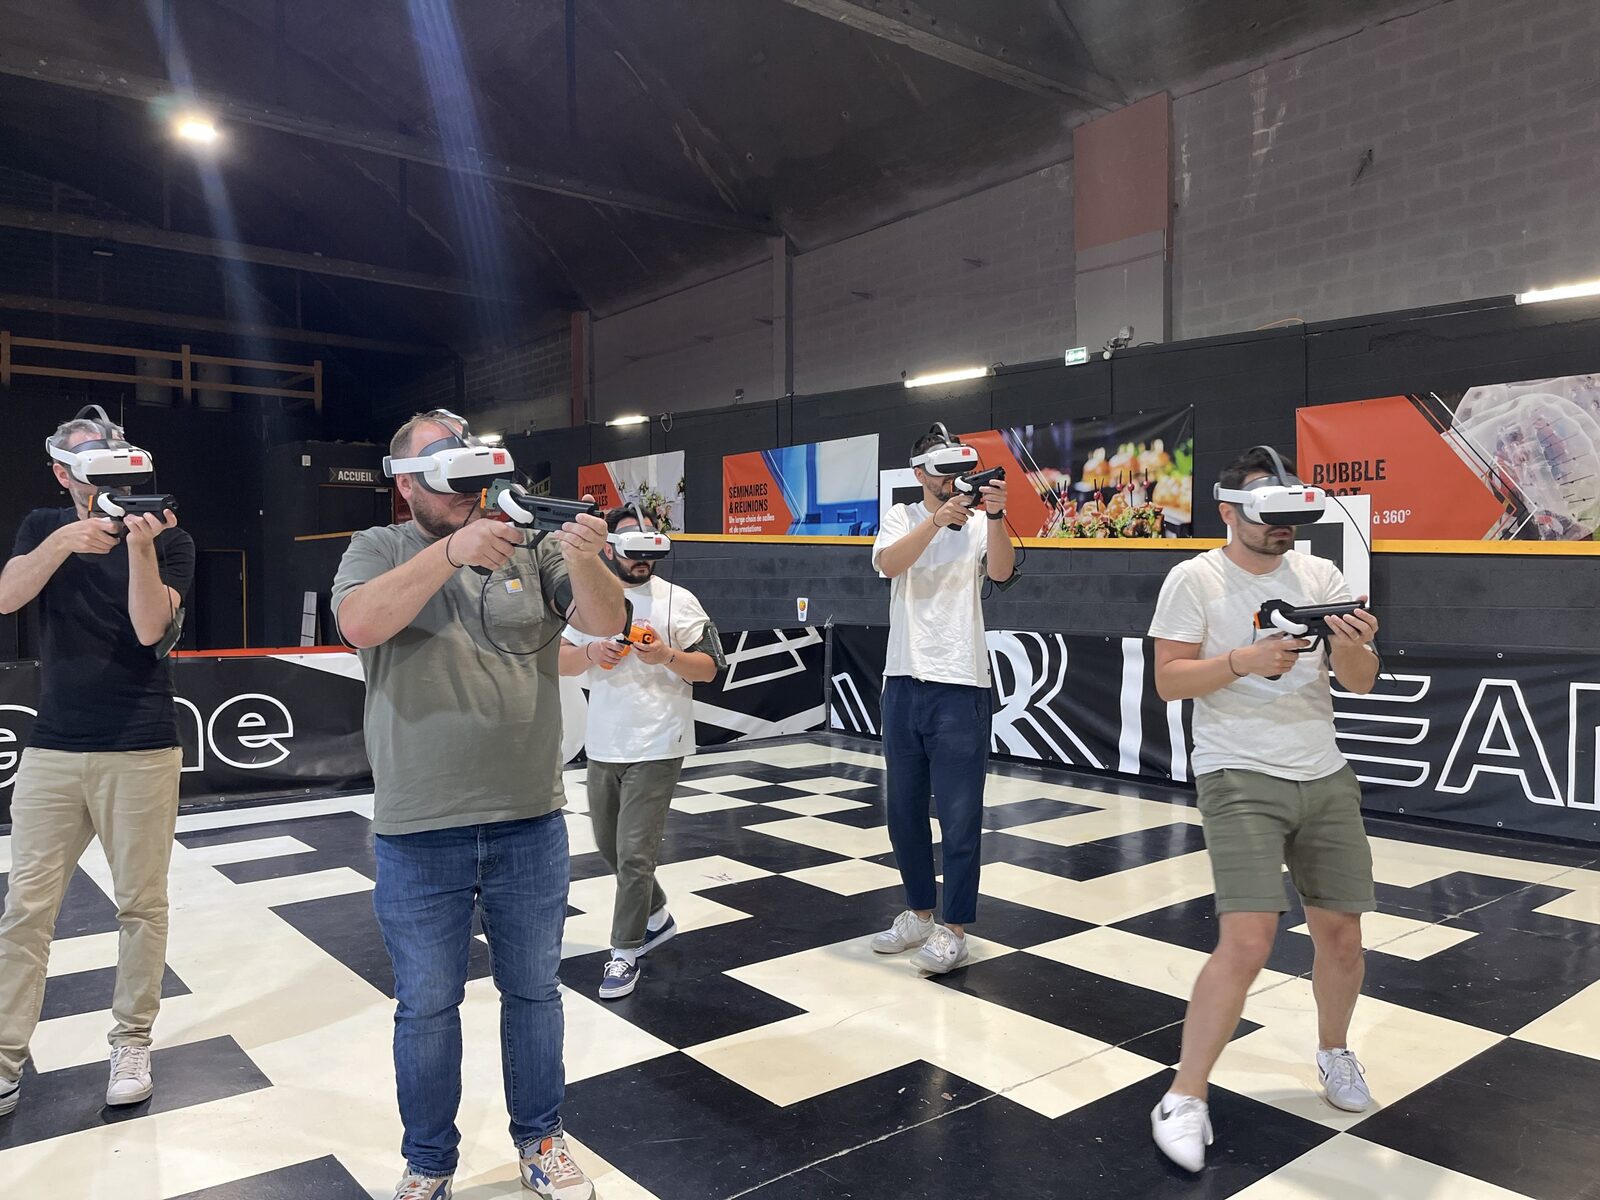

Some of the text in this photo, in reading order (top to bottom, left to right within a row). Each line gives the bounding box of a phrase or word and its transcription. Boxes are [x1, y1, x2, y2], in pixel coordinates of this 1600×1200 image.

[337, 470, 374, 482] ACCUEIL
[1313, 459, 1386, 484] BUBBLE
[1372, 509, 1411, 524] à 360°
